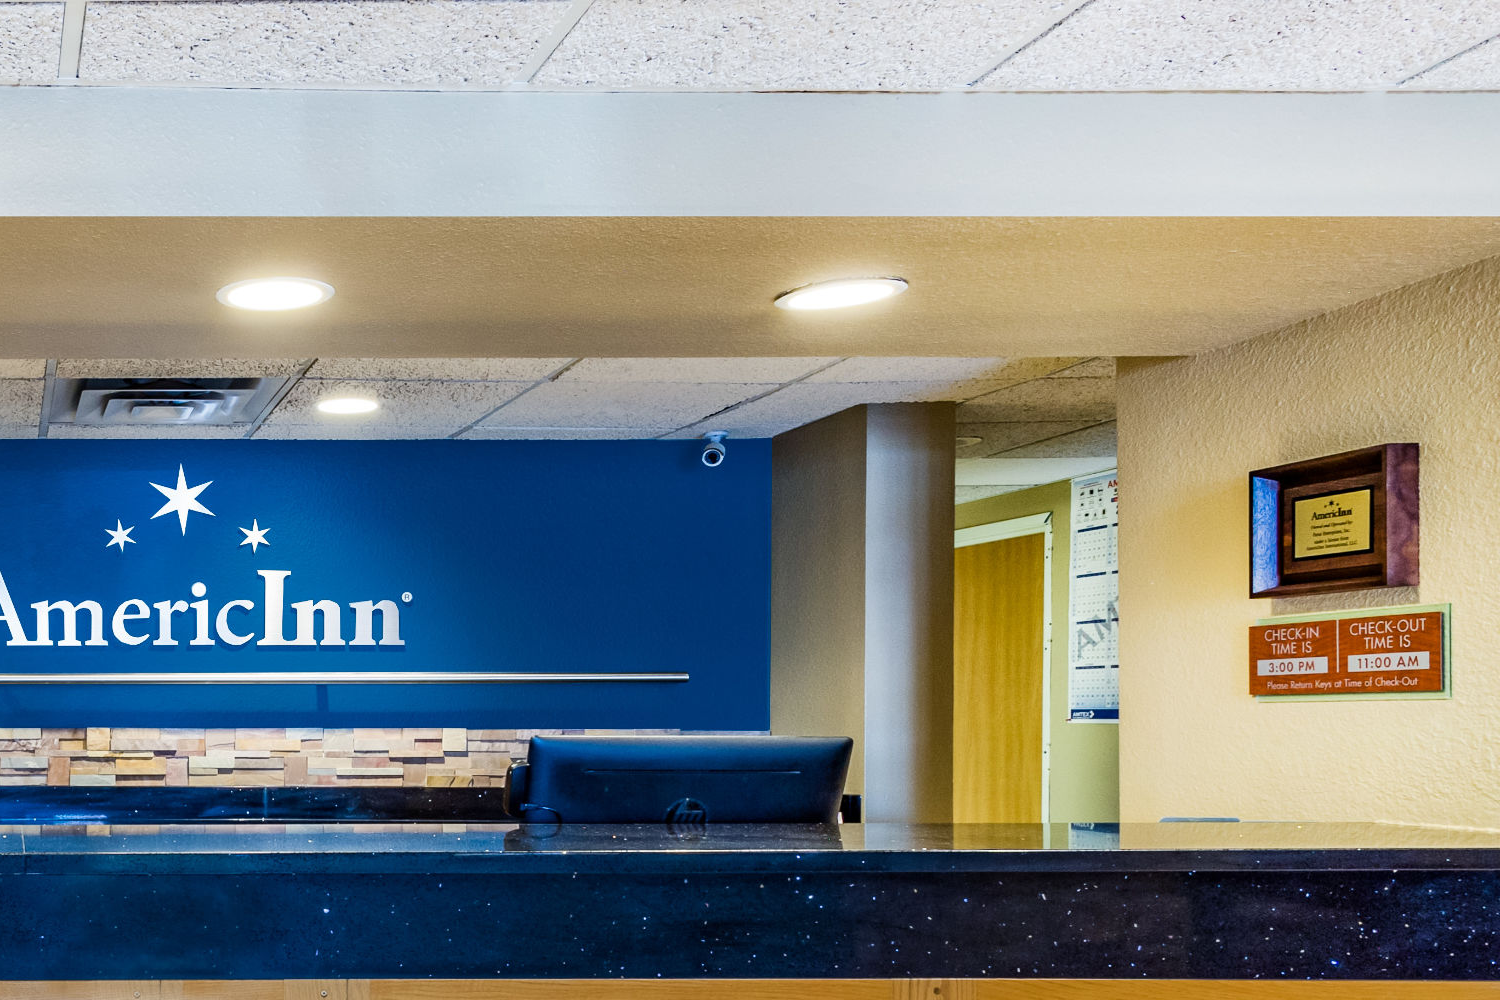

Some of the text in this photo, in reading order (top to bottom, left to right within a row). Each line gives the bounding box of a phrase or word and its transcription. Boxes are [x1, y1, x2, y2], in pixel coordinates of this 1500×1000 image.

[1310, 507, 1352, 520] AmericInn
[1349, 617, 1427, 636] CHECK-OUT
[1264, 626, 1320, 642] CHECK-IN
[1271, 641, 1313, 655] TIME IS
[1363, 634, 1411, 650] TIME IS
[1268, 660, 1316, 673] 3:00 PM
[1357, 655, 1419, 669] 11:00 AM
[1267, 681, 1289, 690] Please
[1290, 680, 1313, 689] Return
[1314, 680, 1332, 690] Keys
[1343, 678, 1362, 687] Time
[1364, 676, 1373, 687] of
[1374, 676, 1419, 687] Check-Out
